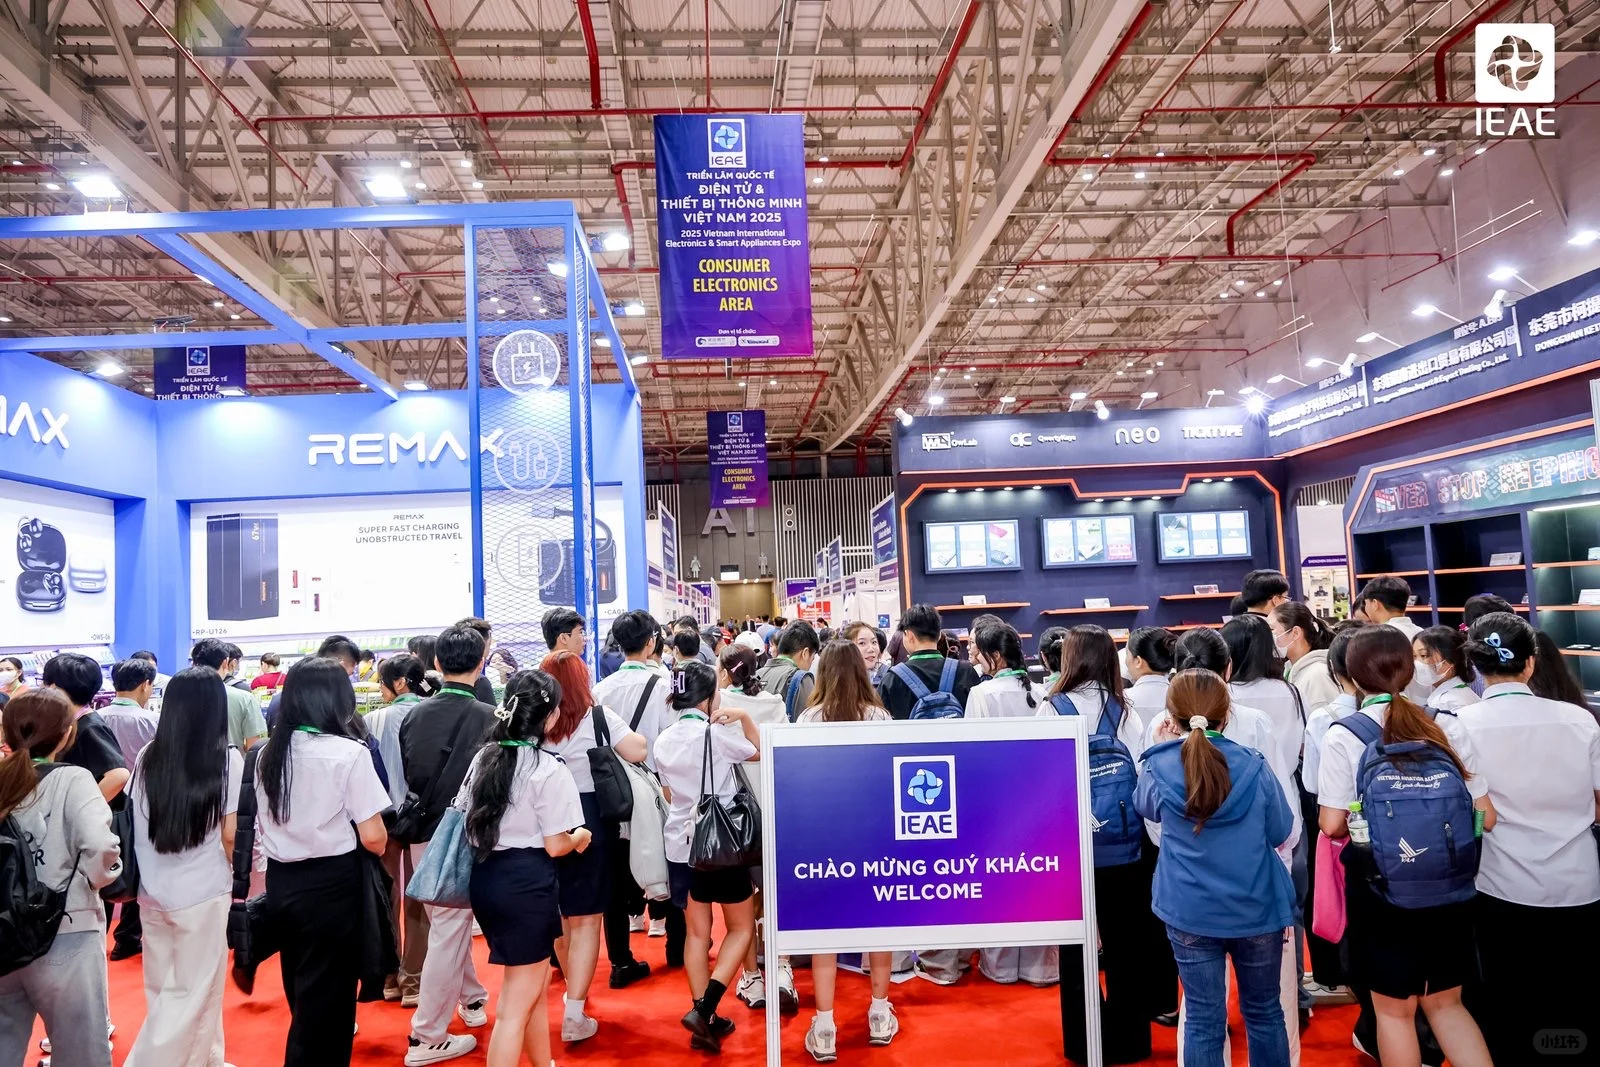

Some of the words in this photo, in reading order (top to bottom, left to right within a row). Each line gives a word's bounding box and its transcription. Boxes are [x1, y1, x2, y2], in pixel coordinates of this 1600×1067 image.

[711, 155, 744, 166] IEAE
[686, 169, 714, 180] TRIỂN
[735, 169, 761, 180] QUỐC
[763, 169, 775, 179] TẾ
[698, 182, 731, 197] ĐIỆN
[734, 180, 752, 195] TỬ
[755, 184, 764, 194] &
[660, 195, 698, 210] THIẾT
[702, 199, 715, 211] BỊ
[718, 196, 766, 209] THÔNG
[769, 198, 802, 209] MINH
[683, 210, 713, 225] VIỆT
[716, 213, 747, 223] NAM
[749, 212, 782, 223] 2025
[680, 229, 701, 238] 2025
[703, 229, 735, 238] Vietnam
[736, 228, 786, 237] International
[665, 239, 707, 248] Electronics
[708, 239, 715, 247] &
[716, 239, 739, 247] Smart
[740, 239, 781, 249] Appliances
[782, 238, 802, 248] Expo
[698, 258, 771, 273] CONSUMER
[693, 277, 778, 293] ELECTRONICS
[719, 297, 754, 312] AREA
[1534, 328, 1584, 352] DONGGUAN
[1115, 427, 1160, 444] neo
[721, 475, 756, 483] ELECTRONICS
[1375, 481, 1429, 514] NEVER
[1437, 469, 1489, 504] STOP
[358, 526, 388, 534] SUPER
[389, 524, 410, 532] FAST
[412, 522, 460, 532] CHARGING
[355, 533, 428, 544] UNOBSTRUCTED
[429, 532, 463, 540] TRAVEL
[1424, 772, 1449, 782] ACADEMY
[900, 814, 953, 835] IEAE
[793, 857, 856, 879] CHÀO
[863, 856, 927, 877] MỪNG
[933, 854, 979, 876] QUÝ
[985, 852, 1059, 874] KHÁCH
[872, 882, 983, 902] WELCOME
